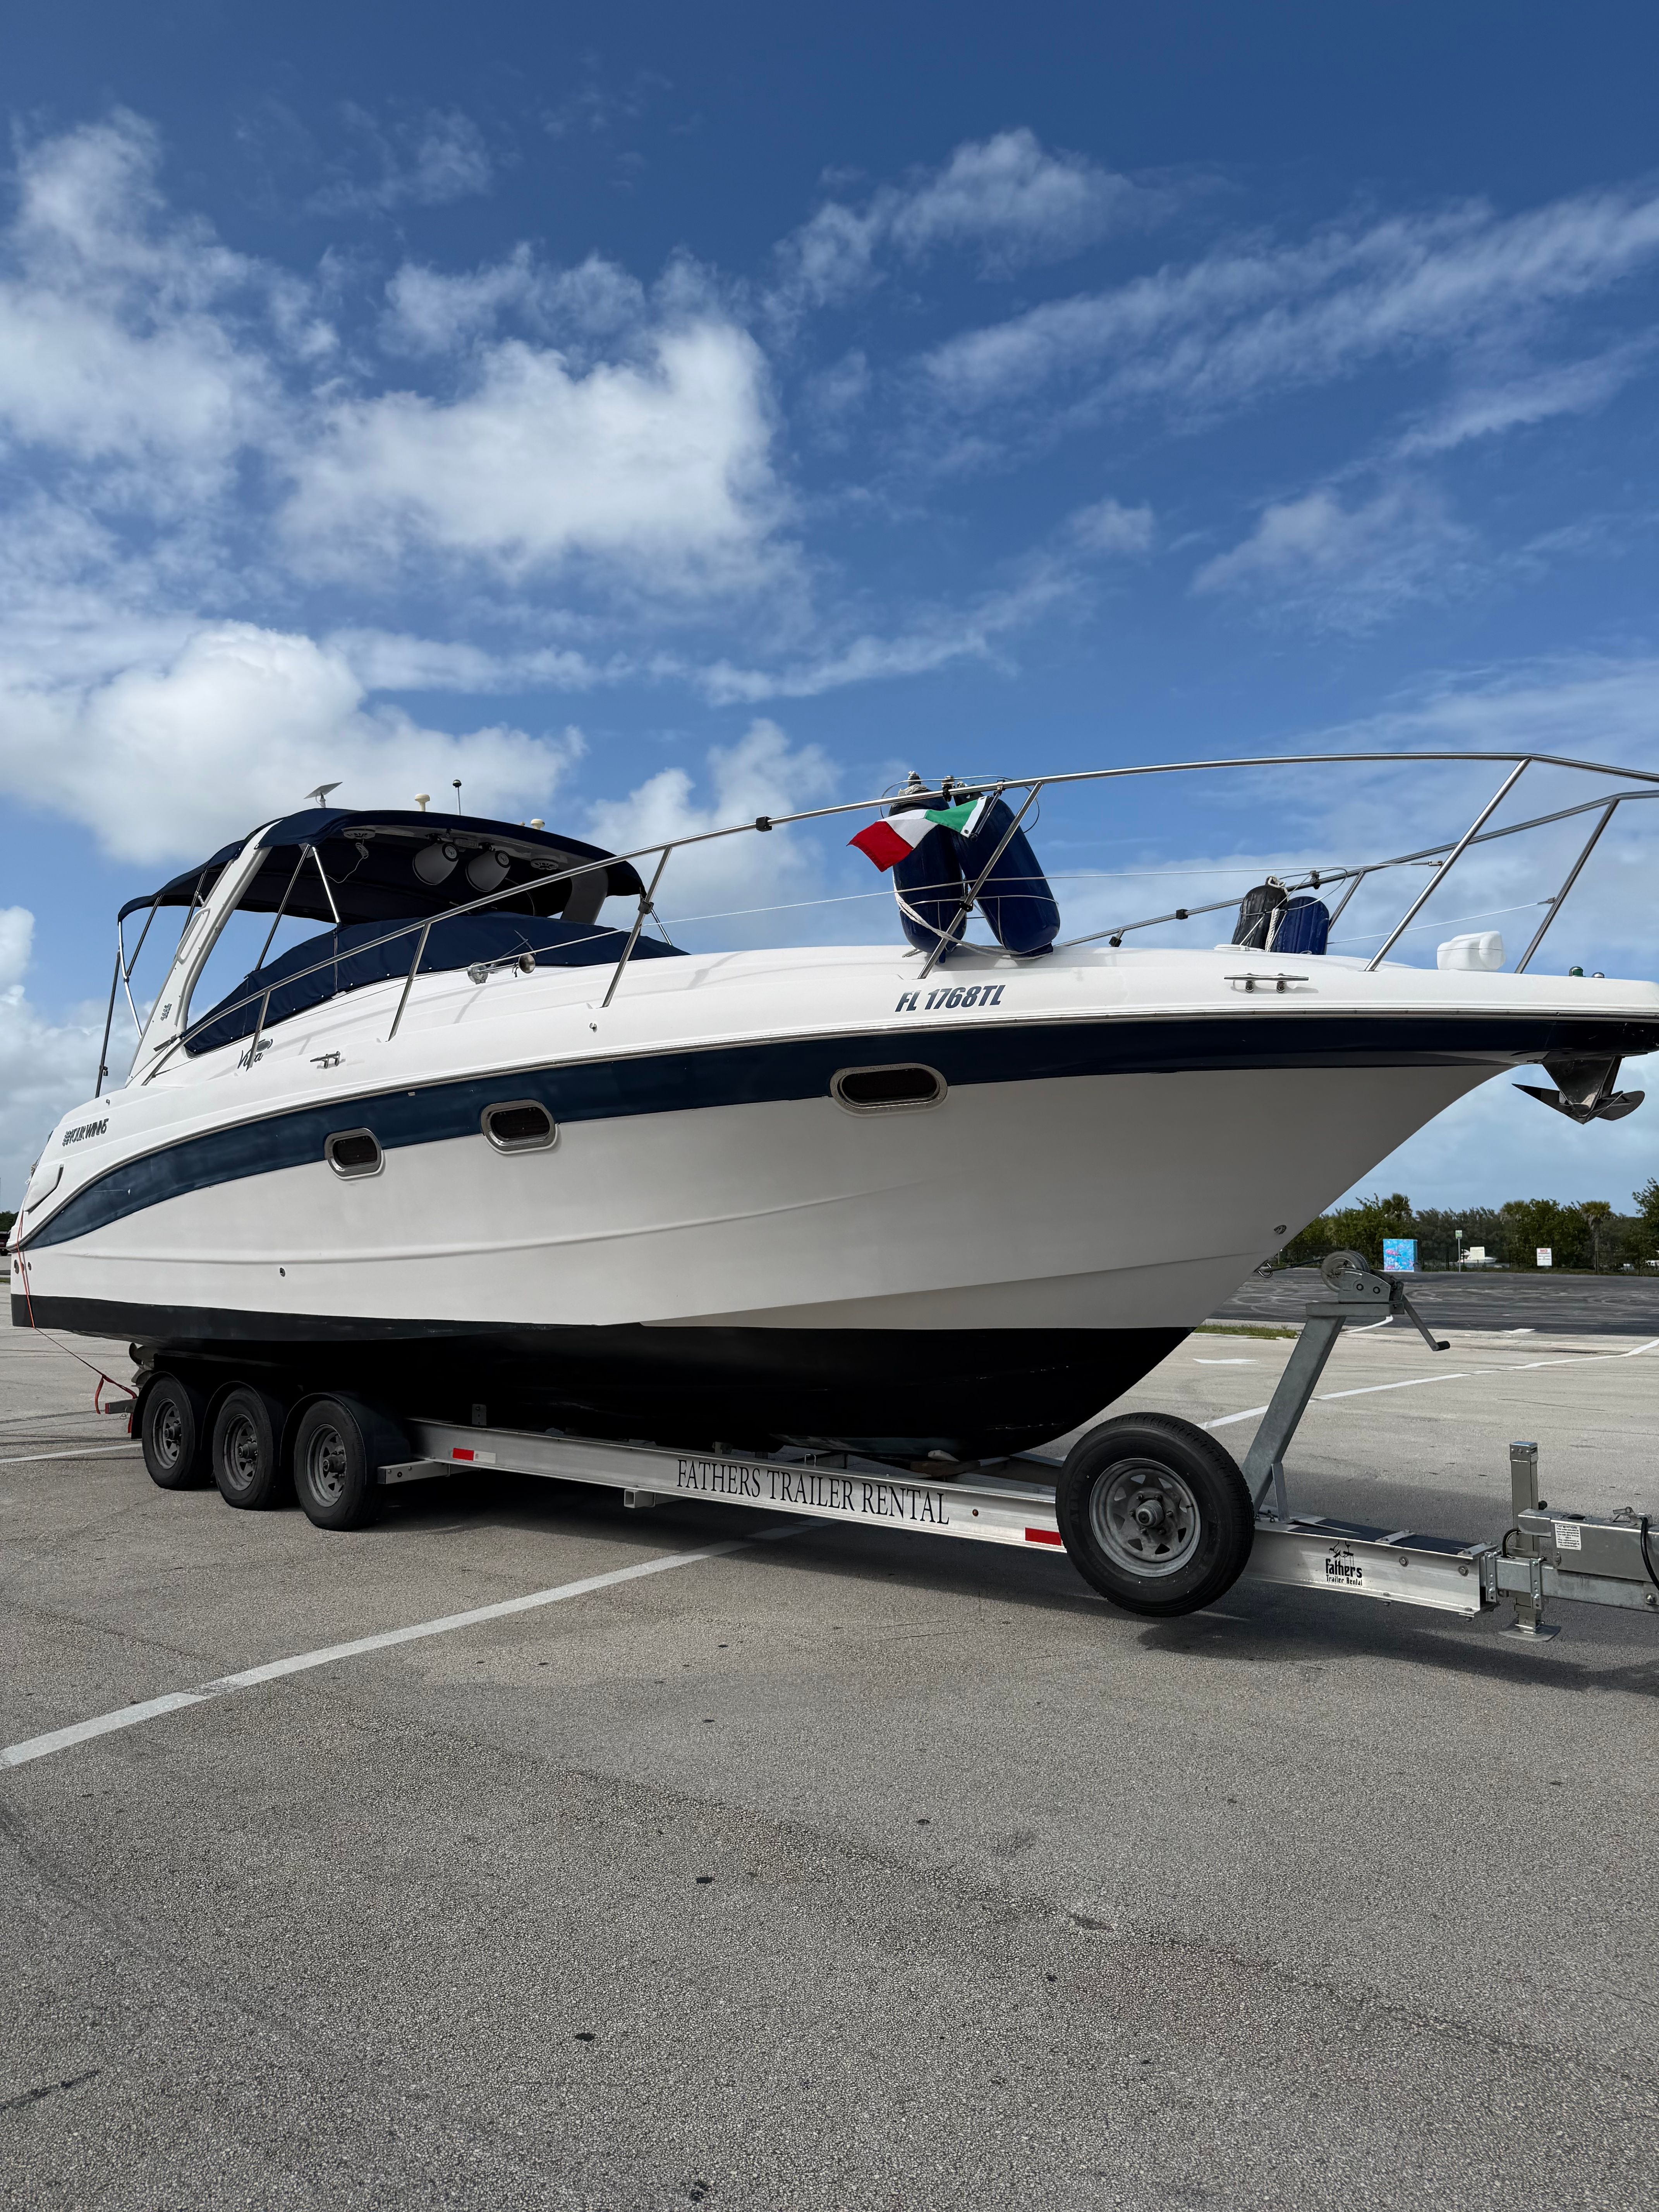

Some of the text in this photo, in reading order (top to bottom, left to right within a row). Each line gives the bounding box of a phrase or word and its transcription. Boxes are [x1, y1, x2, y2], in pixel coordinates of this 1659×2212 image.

[895, 985, 1006, 1012] FL 1768TL
[677, 1459, 950, 1525] FATHERS TRAILER RENTAL
[1326, 1574, 1362, 1586] Trailer Rental
